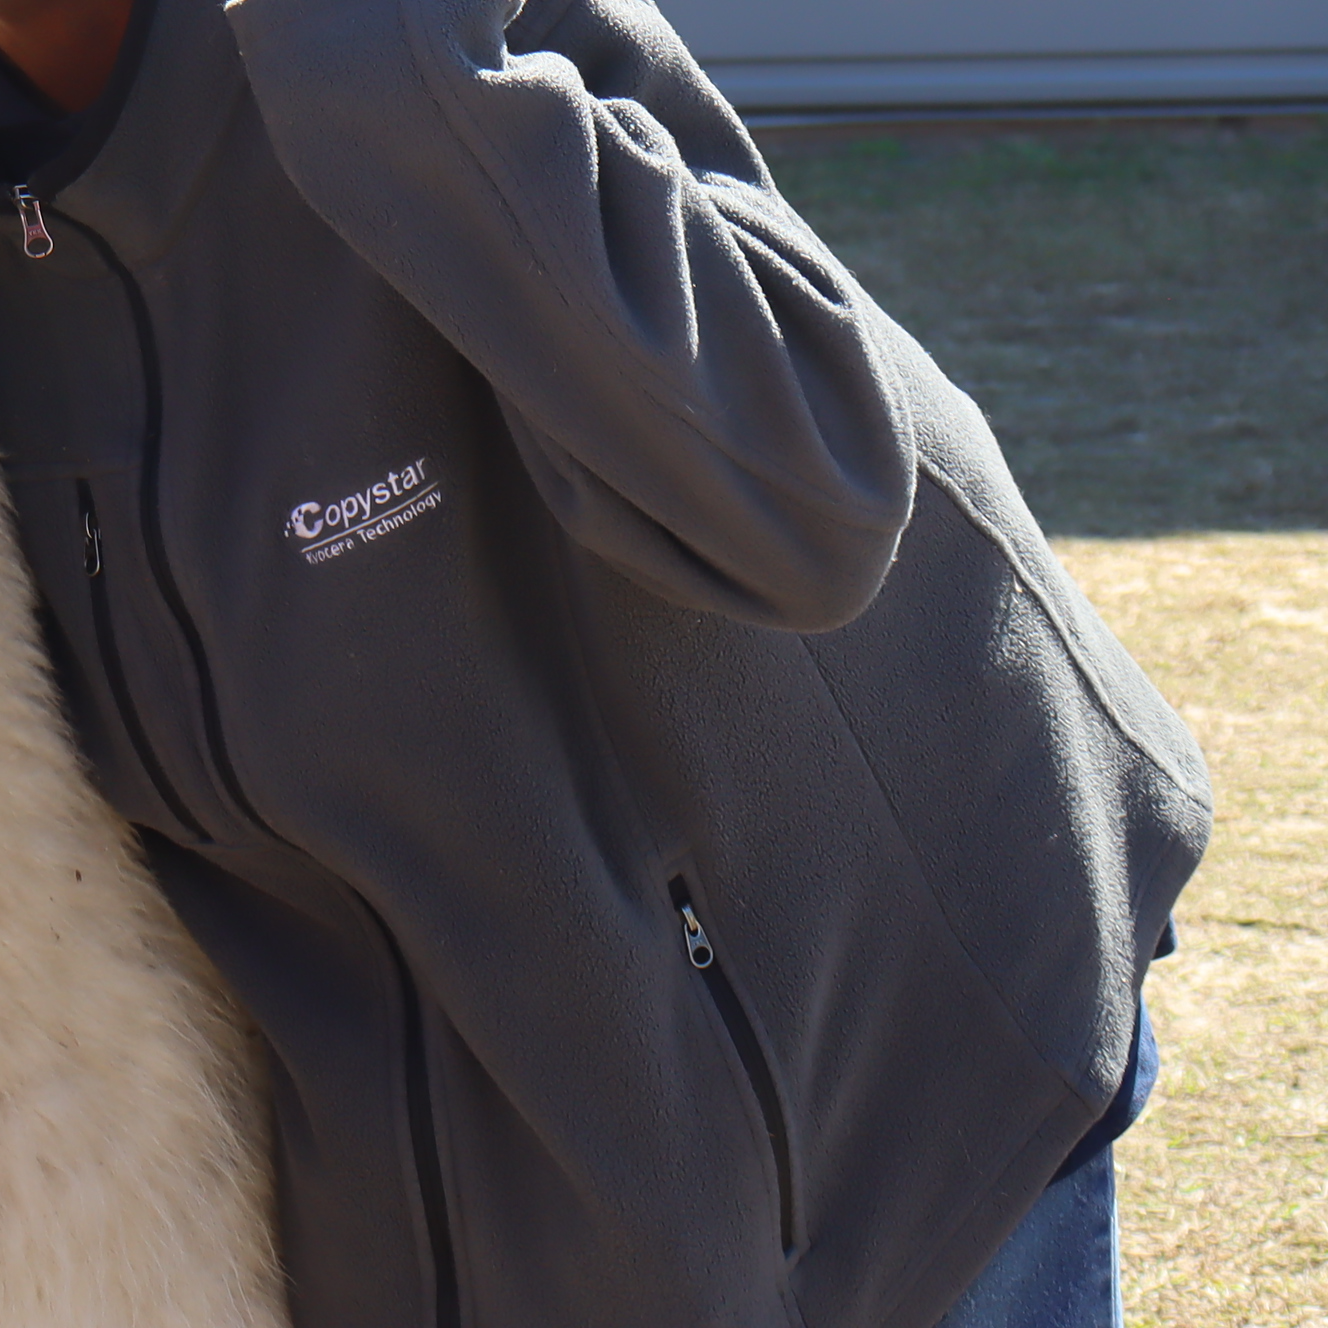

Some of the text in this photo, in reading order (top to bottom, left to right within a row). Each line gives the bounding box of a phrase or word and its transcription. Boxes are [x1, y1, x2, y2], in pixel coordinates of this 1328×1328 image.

[290, 457, 426, 539] Copystar
[305, 490, 442, 565] Kyocera Technology
